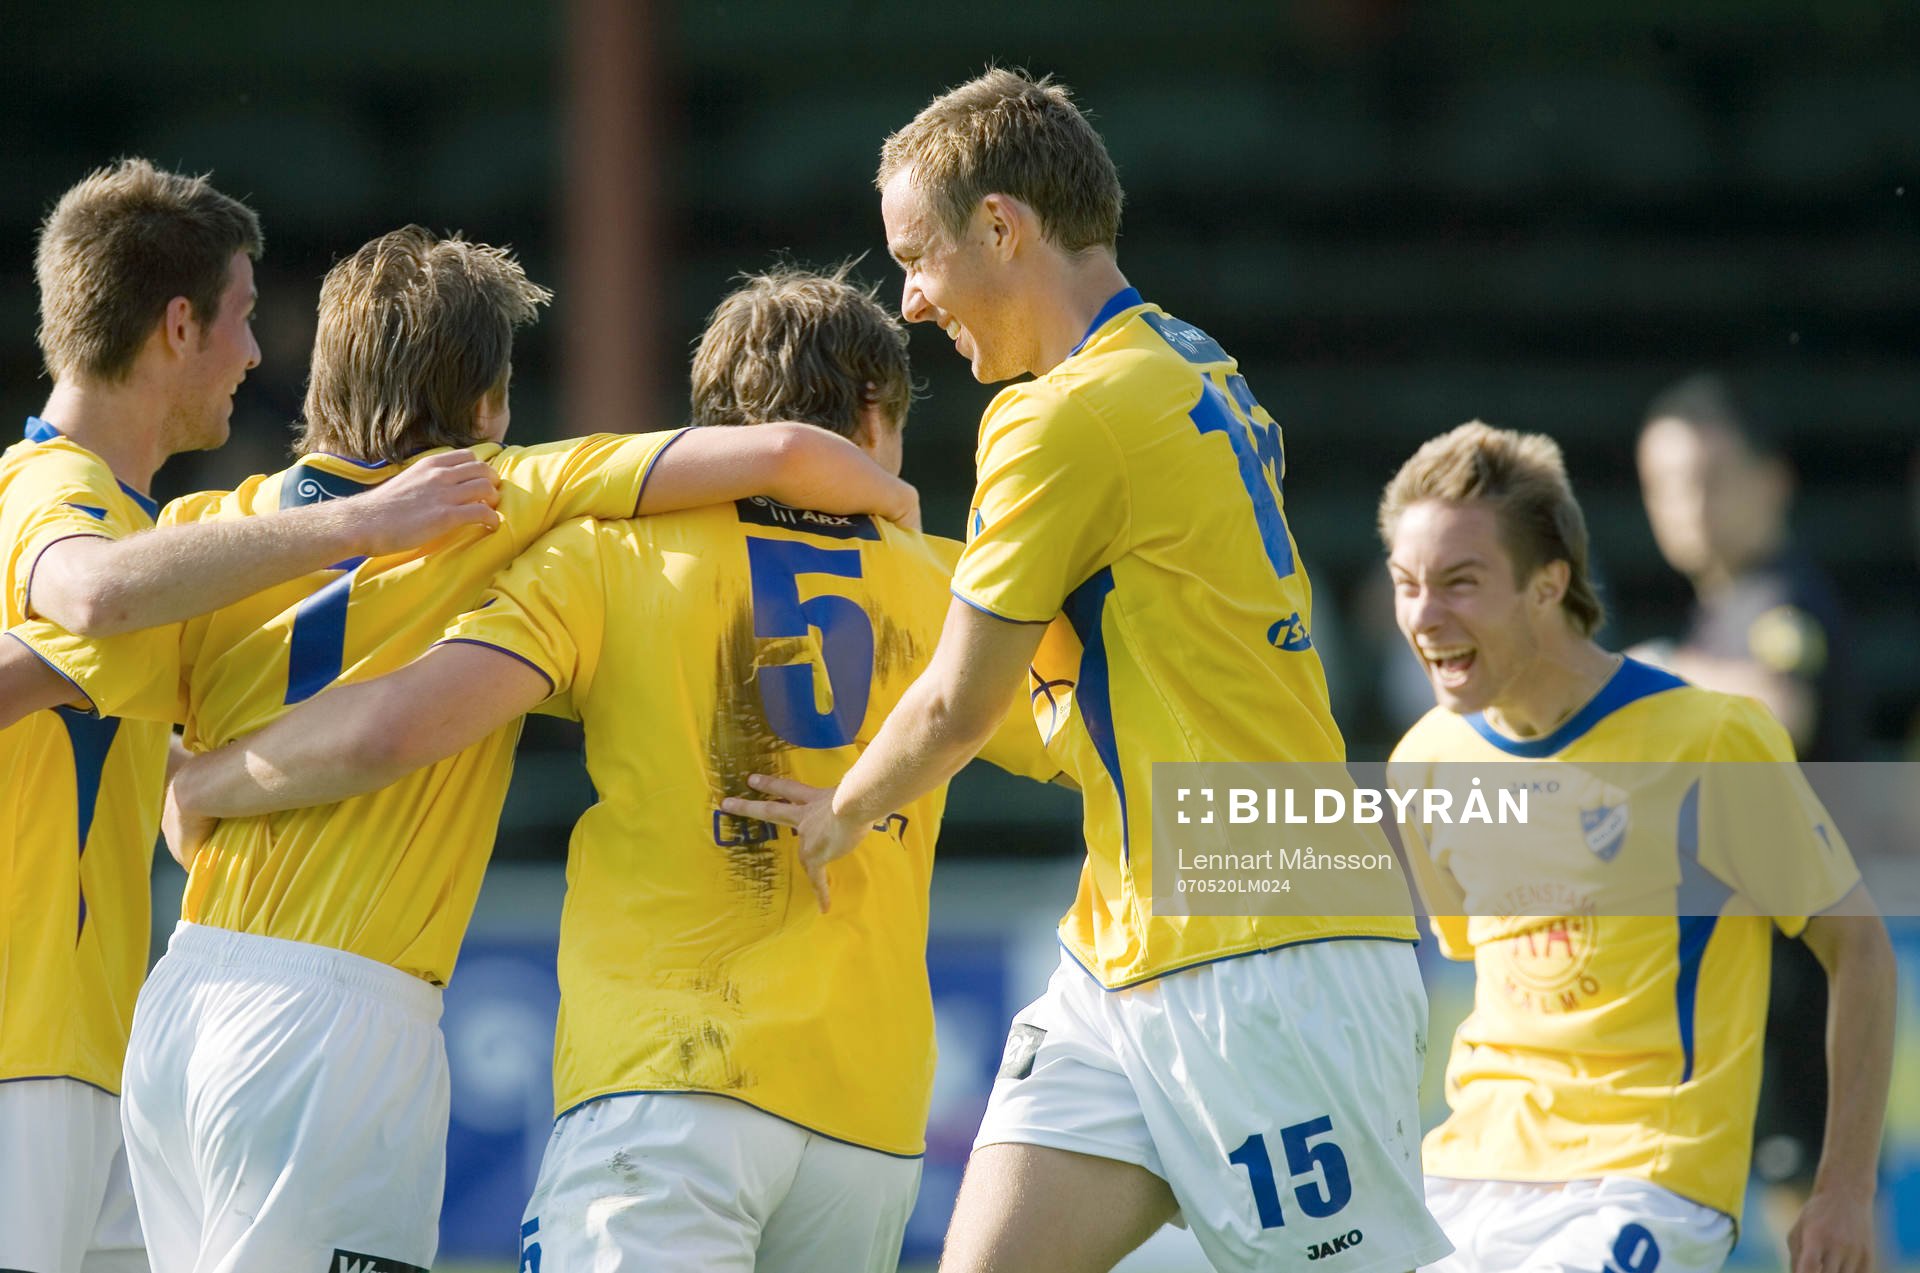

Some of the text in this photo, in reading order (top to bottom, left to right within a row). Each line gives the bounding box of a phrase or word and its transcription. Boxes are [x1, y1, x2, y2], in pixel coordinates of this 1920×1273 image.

[801, 510, 852, 526] ARX
[745, 535, 875, 749] 5
[1228, 1114, 1352, 1229] 15
[1307, 1229, 1363, 1261] JAKO
